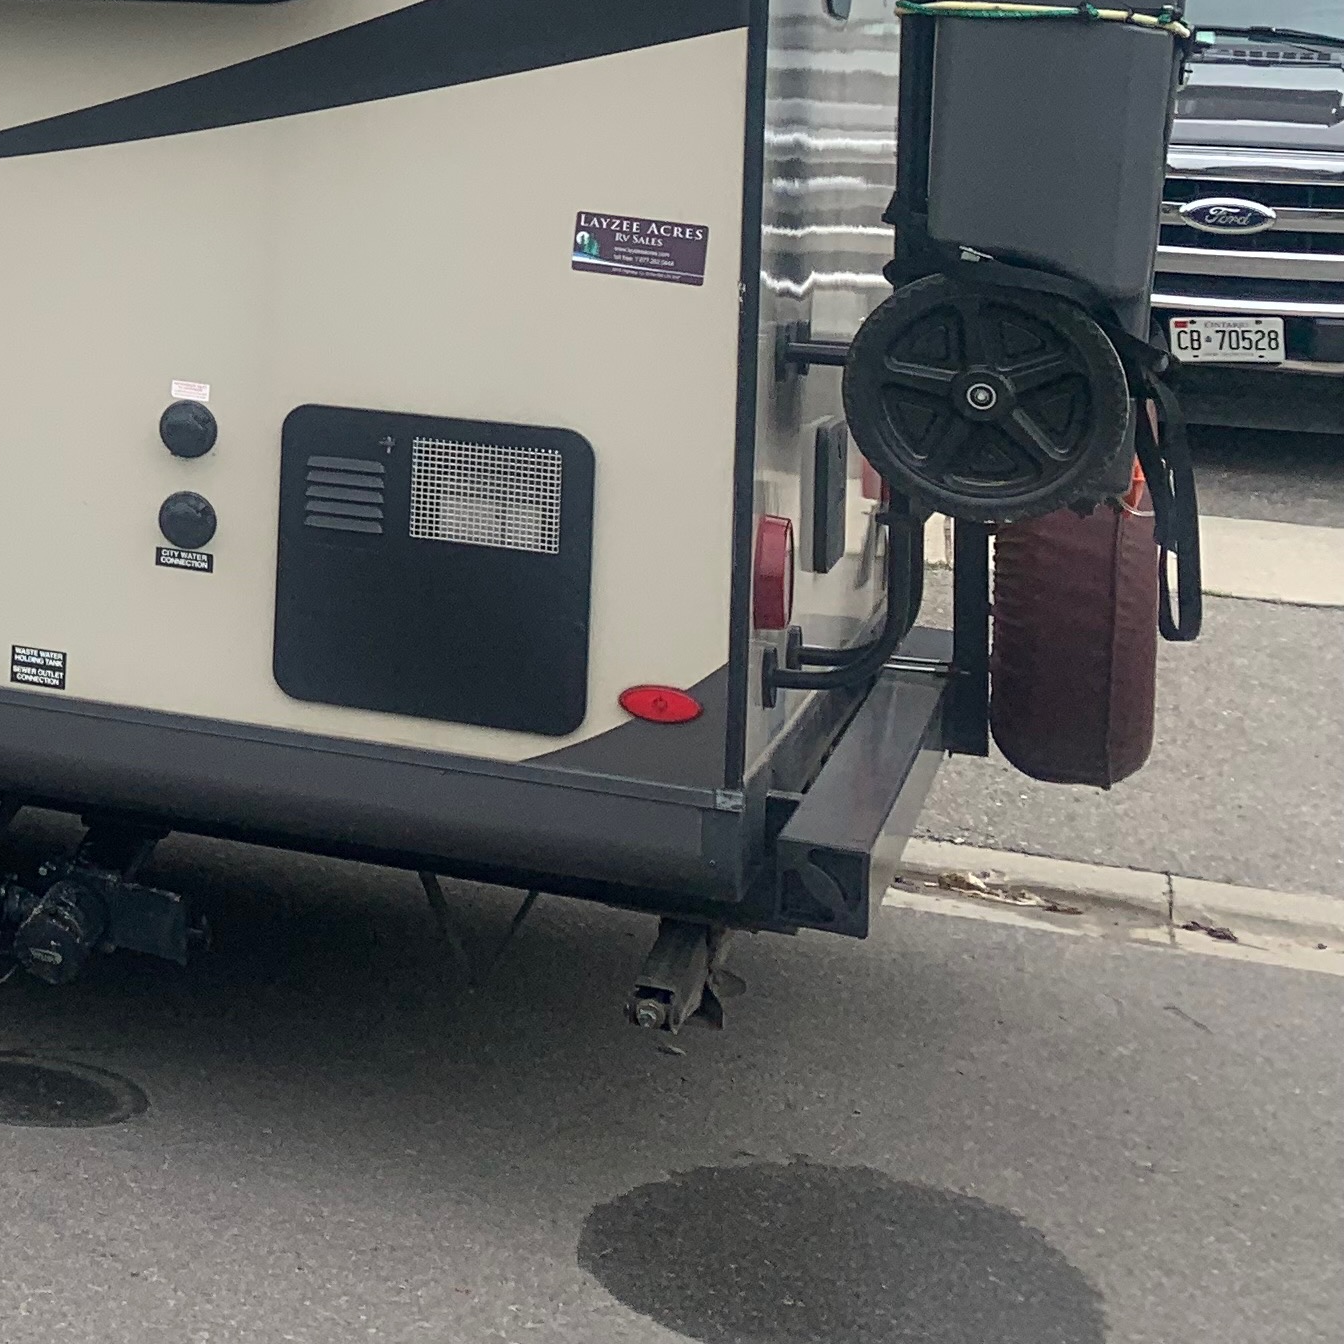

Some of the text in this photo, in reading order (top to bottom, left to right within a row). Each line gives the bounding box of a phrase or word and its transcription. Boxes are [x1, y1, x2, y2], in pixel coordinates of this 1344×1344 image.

[1204, 206, 1251, 226] Ford
[580, 213, 704, 241] LAYZEE ACRES
[632, 235, 664, 247] SALES
[161, 549, 208, 562] CITY WATER
[160, 556, 208, 569] CONNECTION
[37, 668, 64, 679] OUTLET
